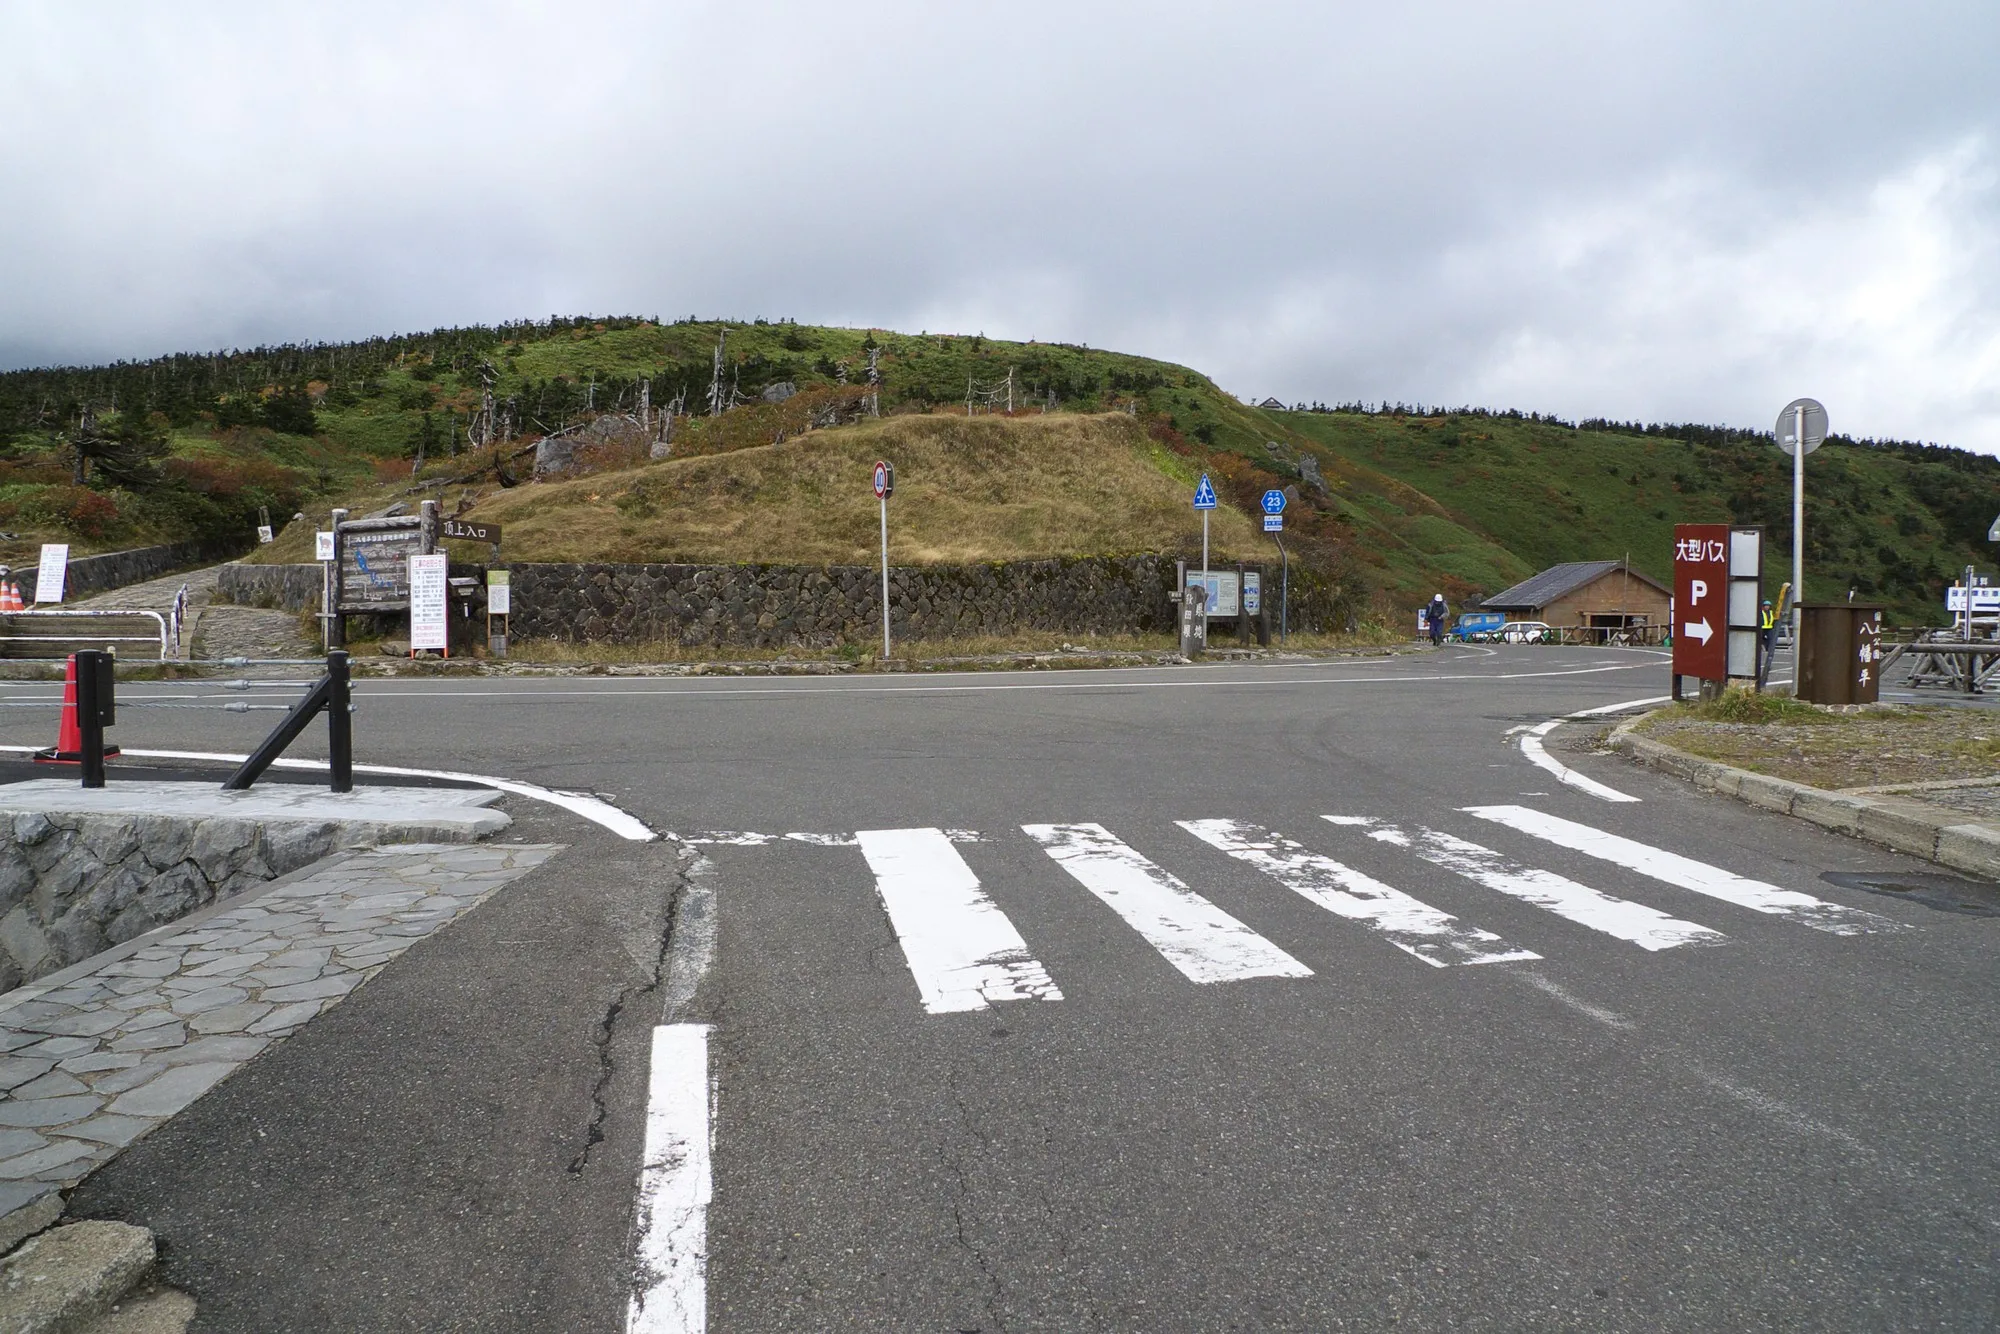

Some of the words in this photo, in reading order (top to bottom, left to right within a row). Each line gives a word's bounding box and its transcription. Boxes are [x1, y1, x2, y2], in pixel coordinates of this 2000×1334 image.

[1267, 497, 1280, 507] 23
[443, 521, 487, 538] 頂上入口
[1676, 538, 1725, 563] 大型バス
[1691, 580, 1708, 606] P
[1183, 593, 1193, 638] 秋田県
[1193, 602, 1204, 639] 県境
[1873, 611, 1882, 660] 国立公園
[1859, 622, 1874, 688] 八幡平
